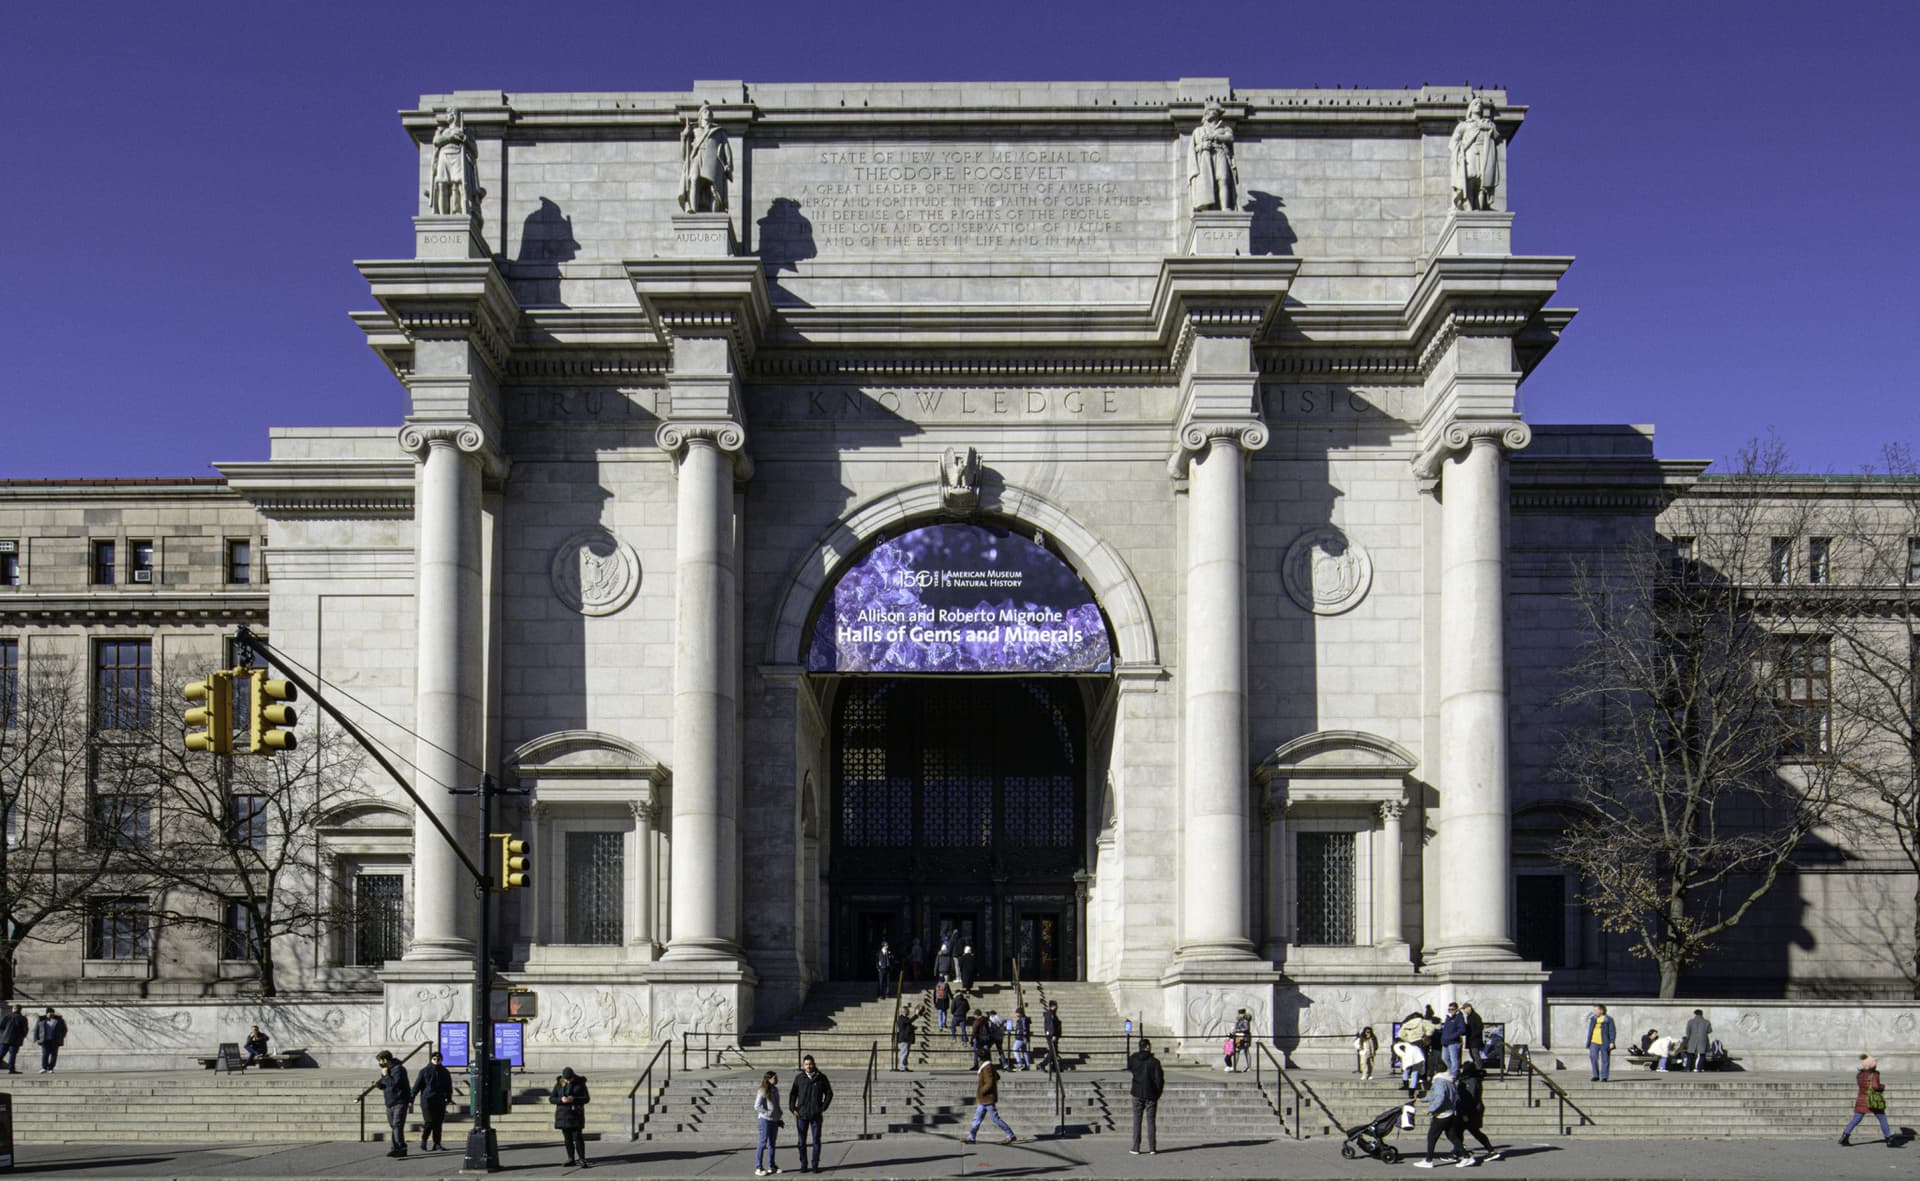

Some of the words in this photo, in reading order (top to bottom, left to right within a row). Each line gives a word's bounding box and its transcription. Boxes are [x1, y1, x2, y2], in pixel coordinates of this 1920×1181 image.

[821, 151, 866, 164] STATE
[873, 151, 893, 164] OF
[901, 151, 934, 164] NEW
[943, 151, 982, 164] YORK
[992, 151, 1075, 164] MEMORIAL
[1080, 151, 1101, 164] TO
[854, 167, 955, 180] THEODORE
[963, 167, 1067, 180] ROOSEVELT
[802, 184, 810, 194] A
[817, 184, 861, 194] GREAT
[868, 184, 918, 194] LEADER
[925, 184, 943, 194] OF
[950, 184, 975, 194] THE
[983, 184, 1029, 194] YOUTH
[1036, 184, 1054, 194] OF
[1058, 184, 1119, 194] AMERICA
[843, 197, 870, 208] AND
[876, 197, 946, 208] FORTITUDE
[953, 197, 966, 207] IN
[973, 196, 996, 207] THE
[1000, 196, 1037, 207] FAITH
[1043, 196, 1060, 206] OF
[1065, 196, 1091, 206] OUR
[1097, 196, 1151, 206] FATHERS
[811, 210, 825, 220] IN
[833, 210, 889, 220] DEFENSE
[895, 210, 913, 220] OF
[919, 210, 944, 220] THE
[951, 210, 1000, 220] RIGHTS
[1006, 210, 1024, 220] OF
[1031, 210, 1055, 220] THE
[1062, 210, 1110, 220] PEOPLE
[821, 223, 845, 233] THE
[852, 223, 888, 233] LOVE
[893, 223, 922, 233] AND
[928, 223, 1036, 233] CONSERVATION
[1043, 222, 1060, 232] OF
[1067, 222, 1122, 232] NATURE
[424, 235, 463, 244] BOONE
[825, 236, 854, 247] AND
[860, 236, 878, 247] OF
[884, 236, 909, 247] THE
[917, 236, 948, 247] BEST
[954, 236, 968, 247] IN
[976, 236, 1002, 247] LIFE
[1009, 236, 1039, 247] AND
[1046, 236, 1059, 247] IN
[1066, 236, 1096, 247] MAN
[1204, 231, 1242, 240] CLARK
[520, 391, 673, 415] TRUTH
[807, 391, 1118, 414] KNOWLEDGE
[1264, 390, 1405, 413] ISION
[858, 609, 905, 622] Allison
[909, 608, 935, 622] and
[939, 608, 995, 622] Roberto
[999, 609, 1062, 625] Mignone
[838, 626, 882, 642] Halls
[886, 626, 906, 642] of
[909, 627, 960, 642] Gems
[965, 625, 999, 642] and
[1004, 625, 1083, 642] Minerals
